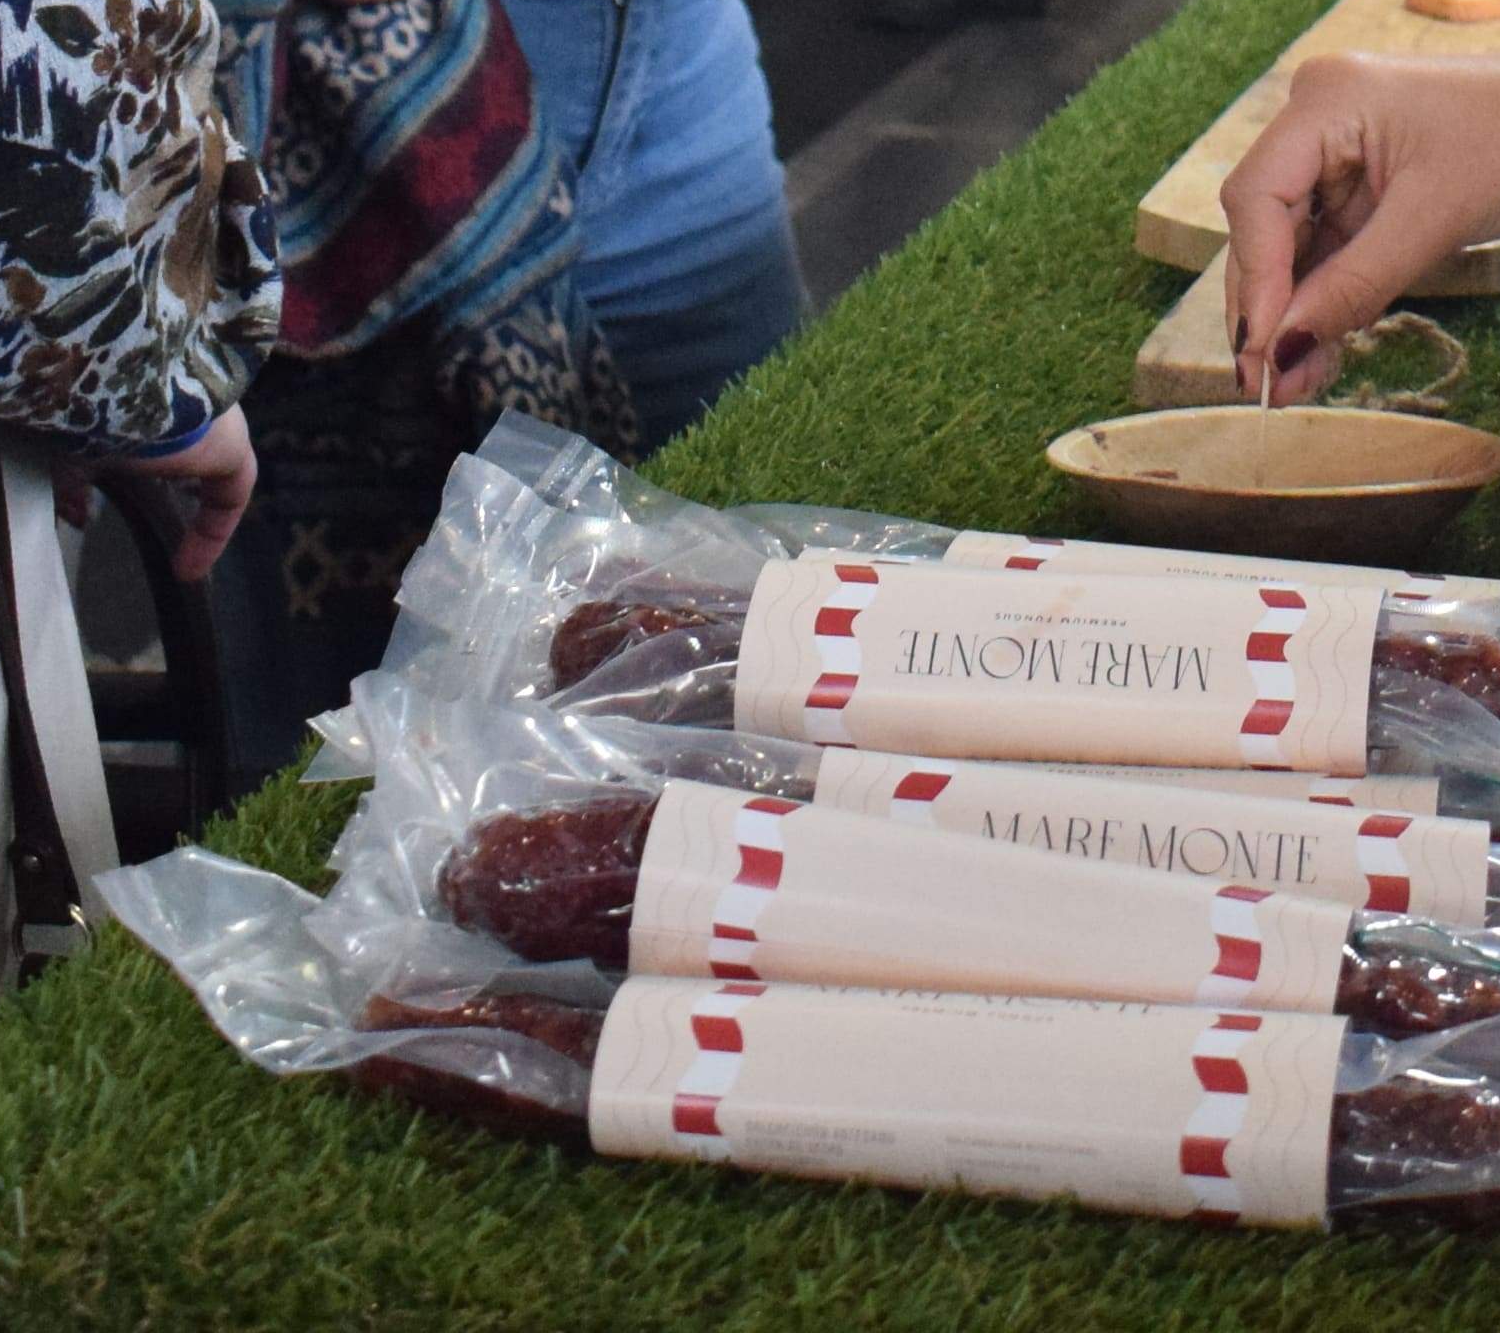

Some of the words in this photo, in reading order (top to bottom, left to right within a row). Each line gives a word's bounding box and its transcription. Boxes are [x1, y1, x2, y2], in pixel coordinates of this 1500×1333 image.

[994, 611, 1054, 624] FUNGUS
[1059, 614, 1128, 628] PREMIUM
[895, 628, 1066, 682] MONTE
[1077, 640, 1212, 692] MARE
[980, 810, 1123, 862] MARE
[1137, 822, 1320, 886] MONTE
